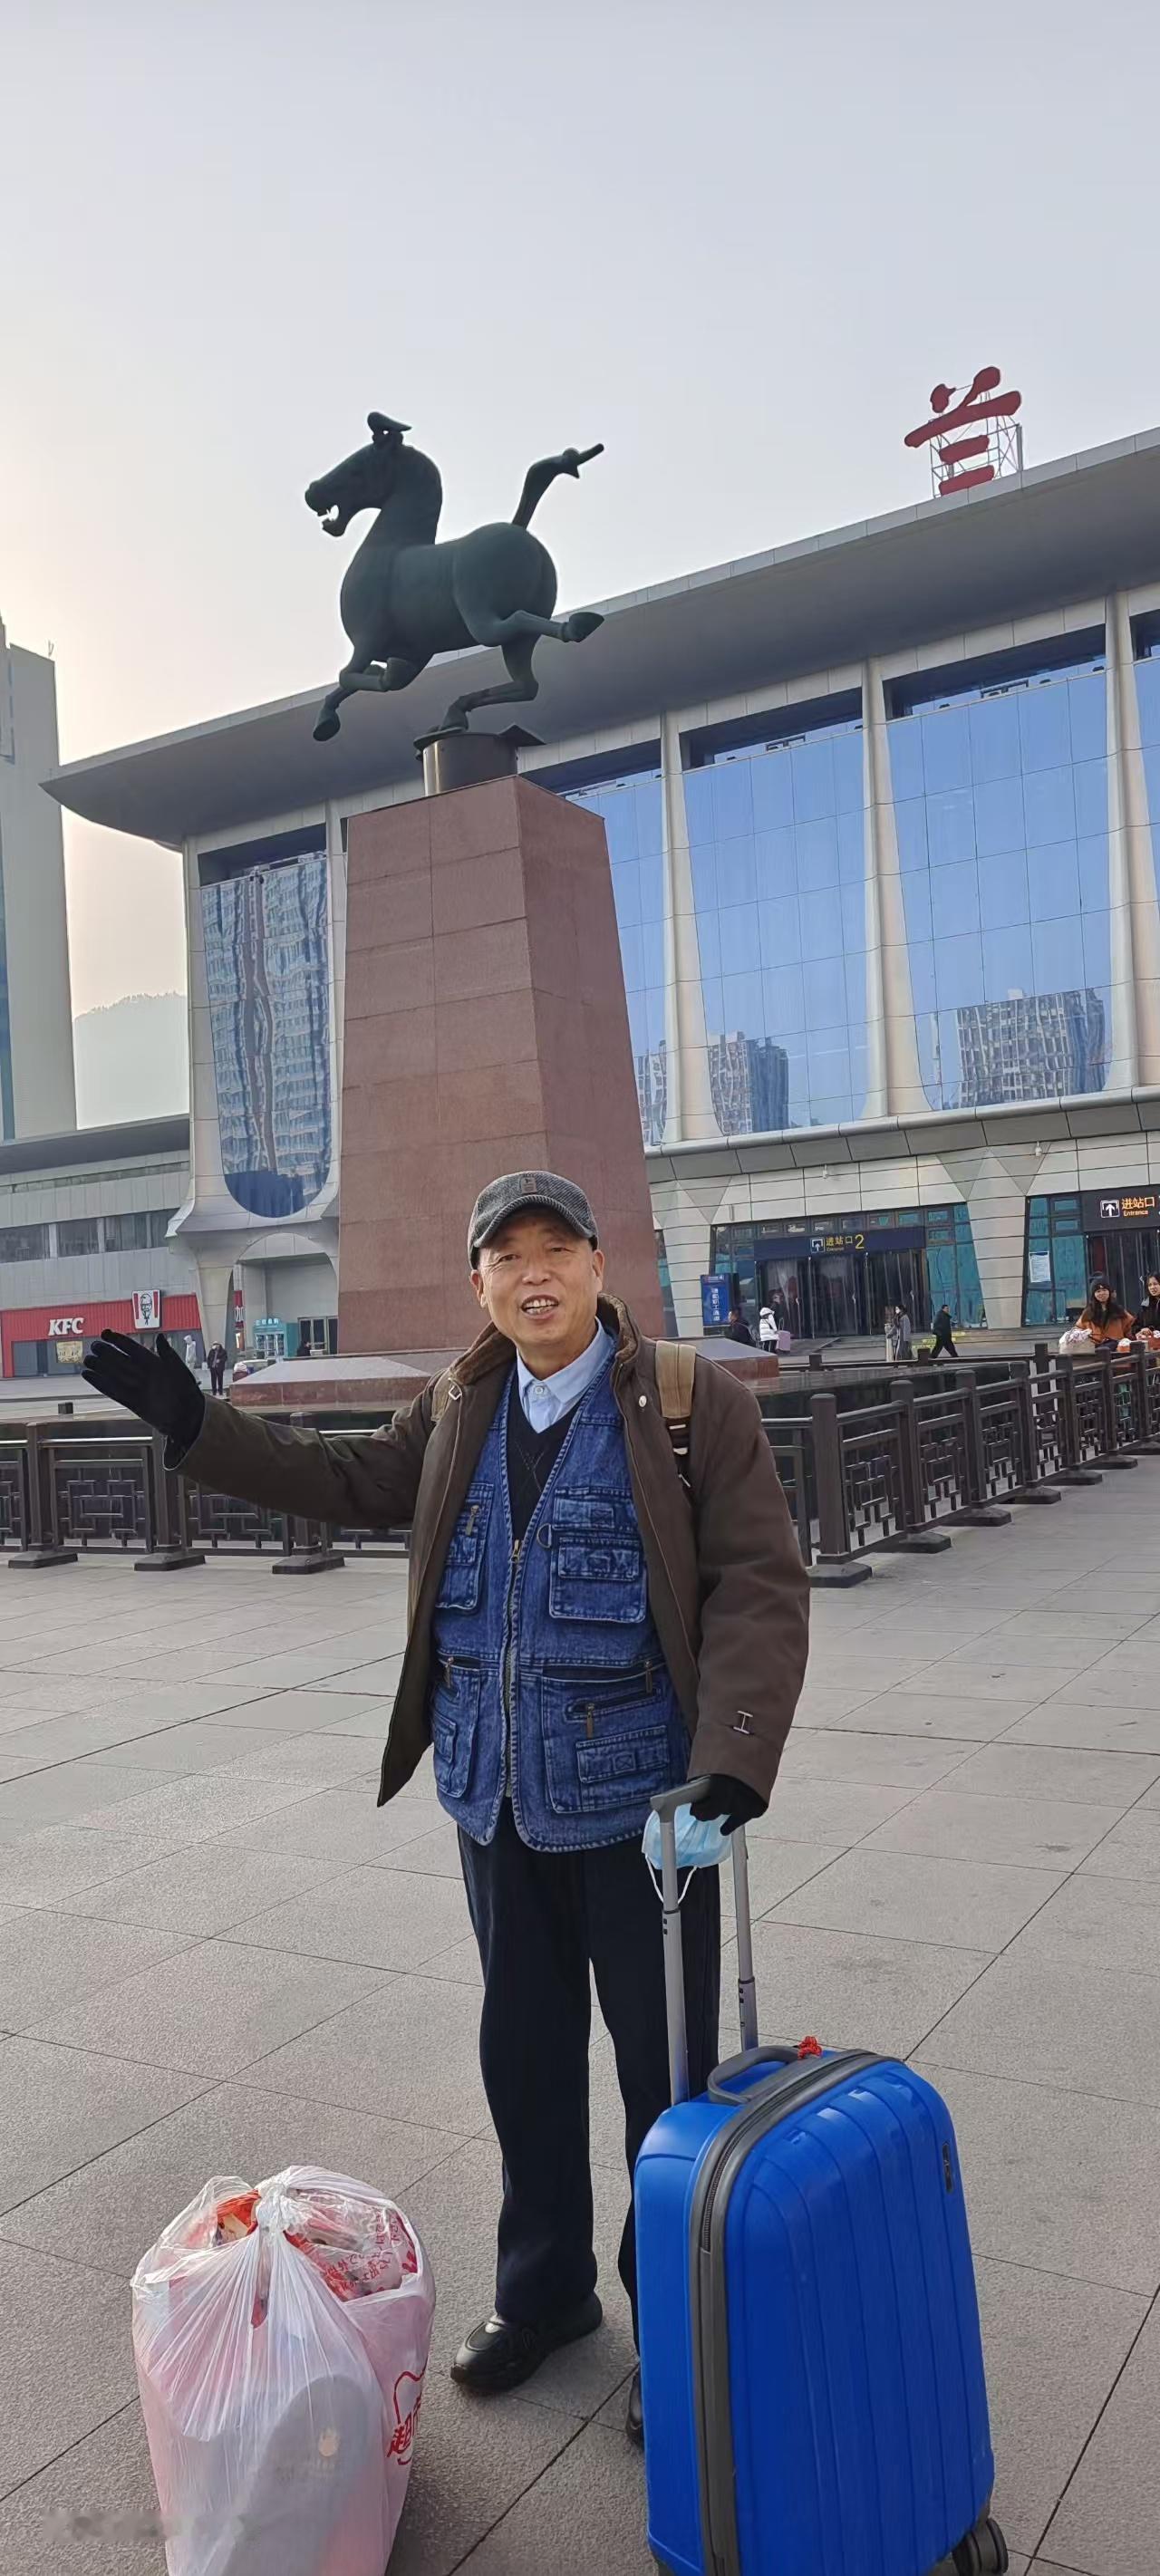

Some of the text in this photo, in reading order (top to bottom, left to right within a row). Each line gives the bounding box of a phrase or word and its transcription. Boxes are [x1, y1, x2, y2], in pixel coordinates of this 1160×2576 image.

[904, 366, 1021, 497] 兰
[1121, 1197, 1155, 1210] 进站口
[48, 1317, 84, 1336] KFC
